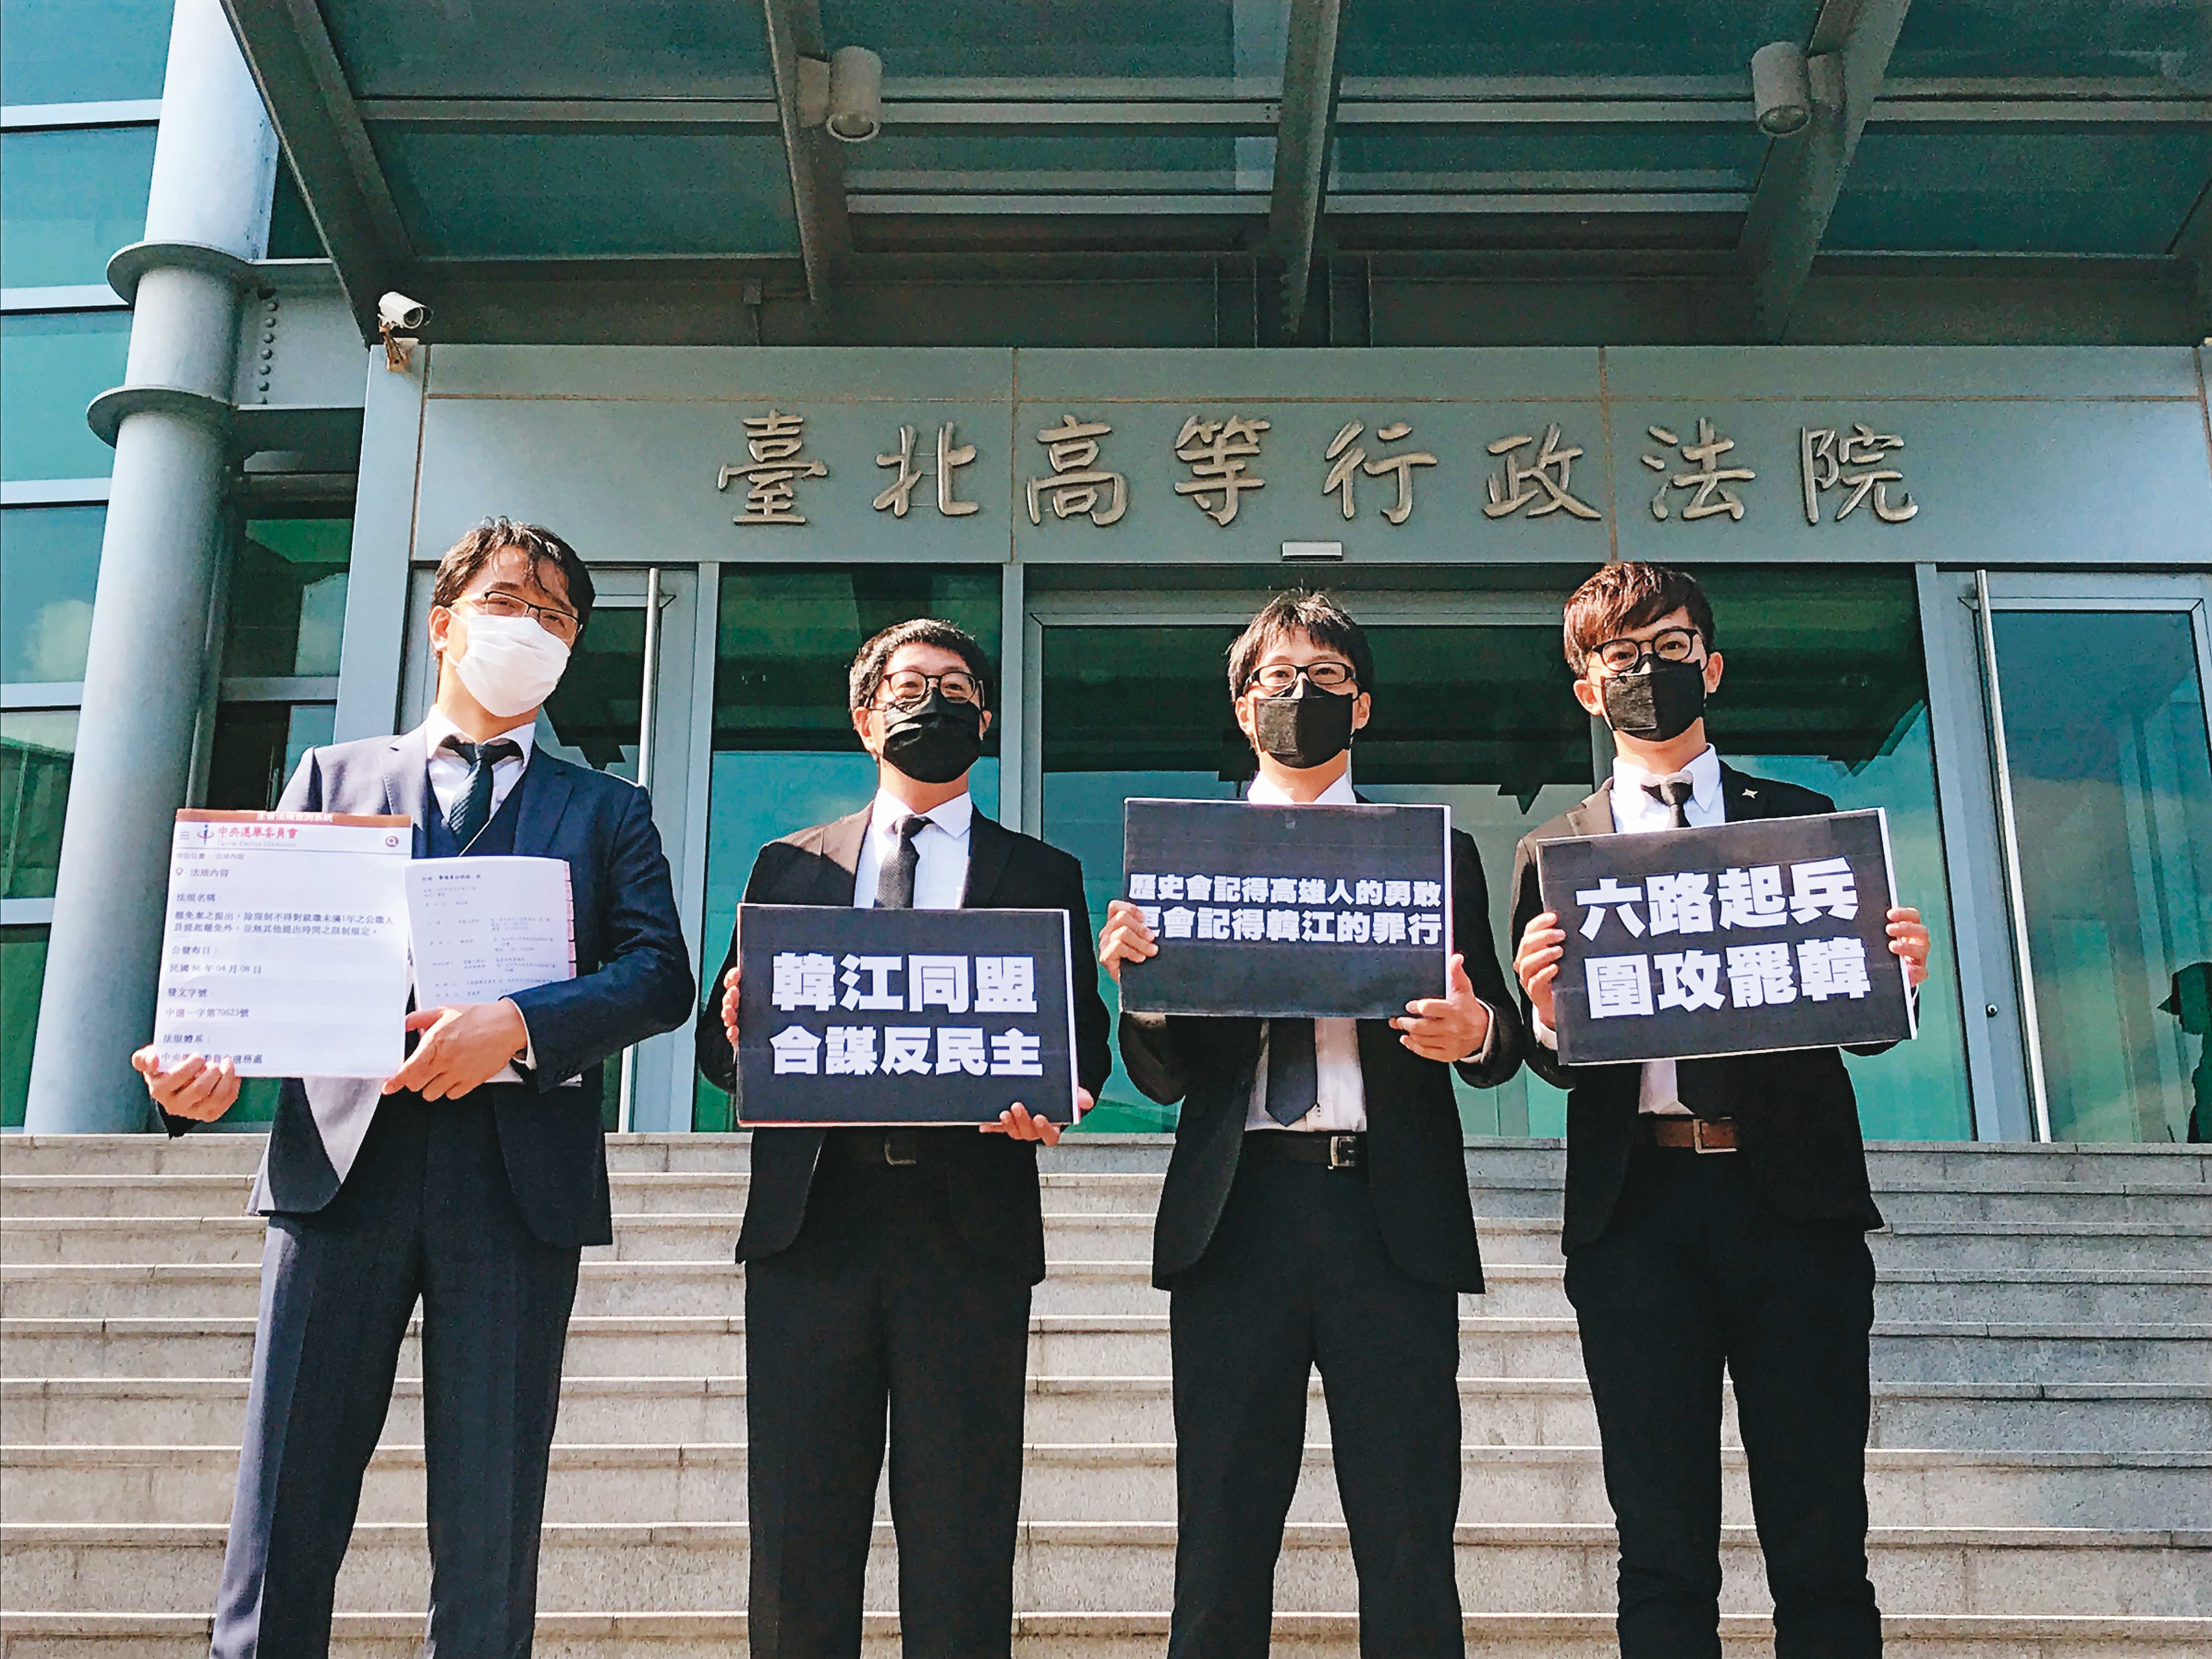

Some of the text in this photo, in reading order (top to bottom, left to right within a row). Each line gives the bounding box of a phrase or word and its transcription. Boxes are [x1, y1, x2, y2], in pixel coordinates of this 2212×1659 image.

[717, 410, 1919, 525] 臺北高等行政法院
[218, 826, 298, 839] 中央選舉委員會
[1128, 873, 1441, 908] 歷史會記得高雄人的勇敢
[1575, 857, 1860, 941] 六路起兵
[771, 951, 1037, 1013] 韓江同盟
[1584, 937, 1871, 1019] 圍攻罷韓
[161, 1052, 262, 1064] 中央委員選務處
[769, 1025, 1043, 1077] 合謀反民主
